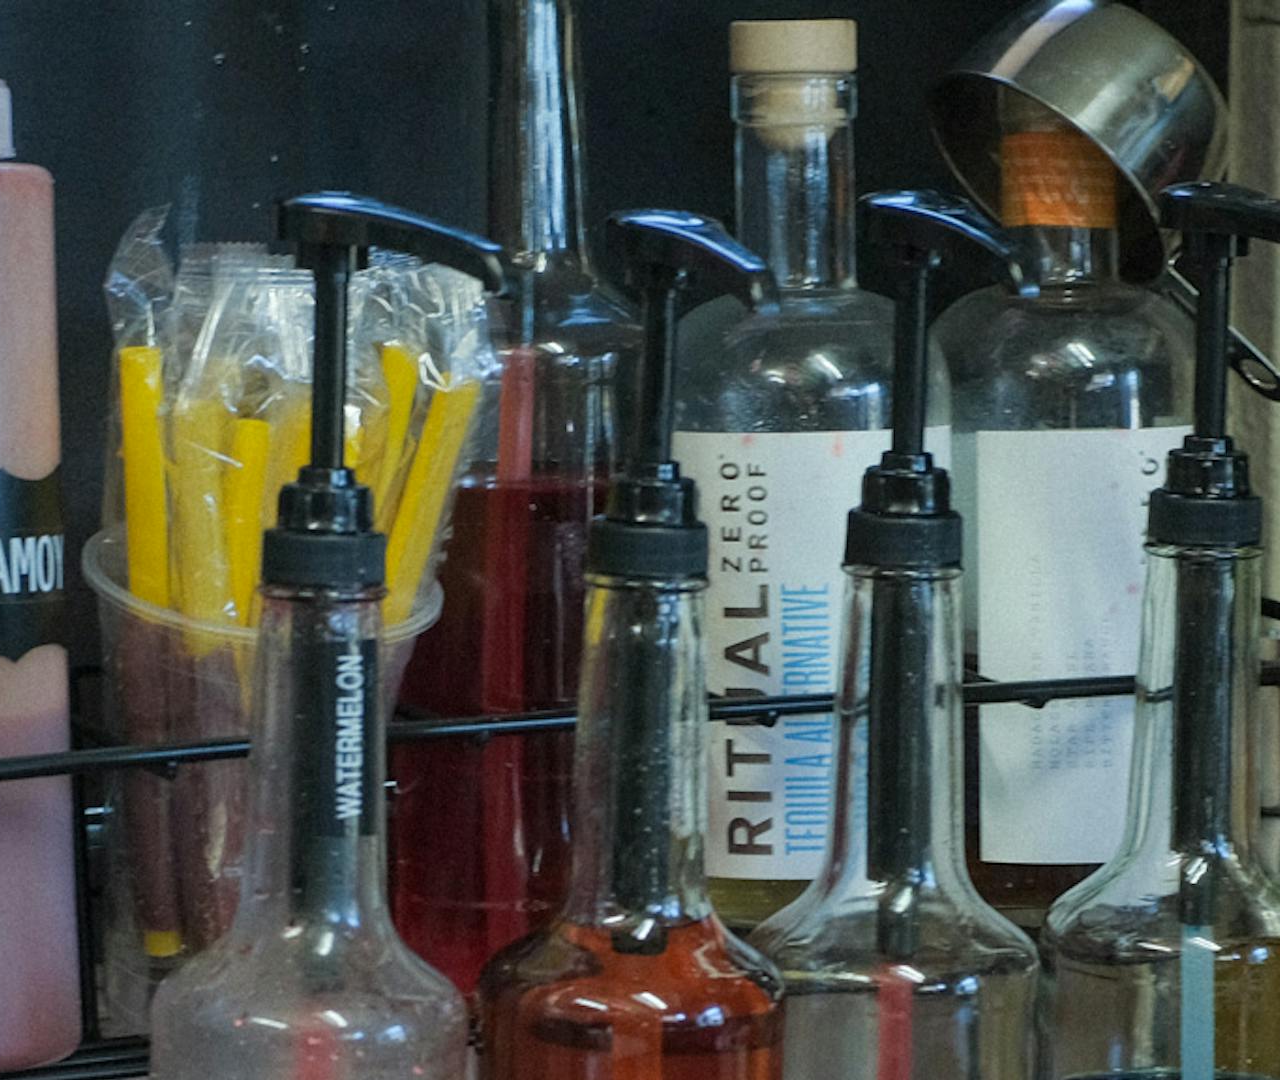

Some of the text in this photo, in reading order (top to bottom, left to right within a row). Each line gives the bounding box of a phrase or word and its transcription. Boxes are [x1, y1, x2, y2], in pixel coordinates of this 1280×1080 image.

[721, 460, 742, 574] ZERO
[748, 463, 770, 574] PROOF
[334, 655, 364, 820] WATERMELON
